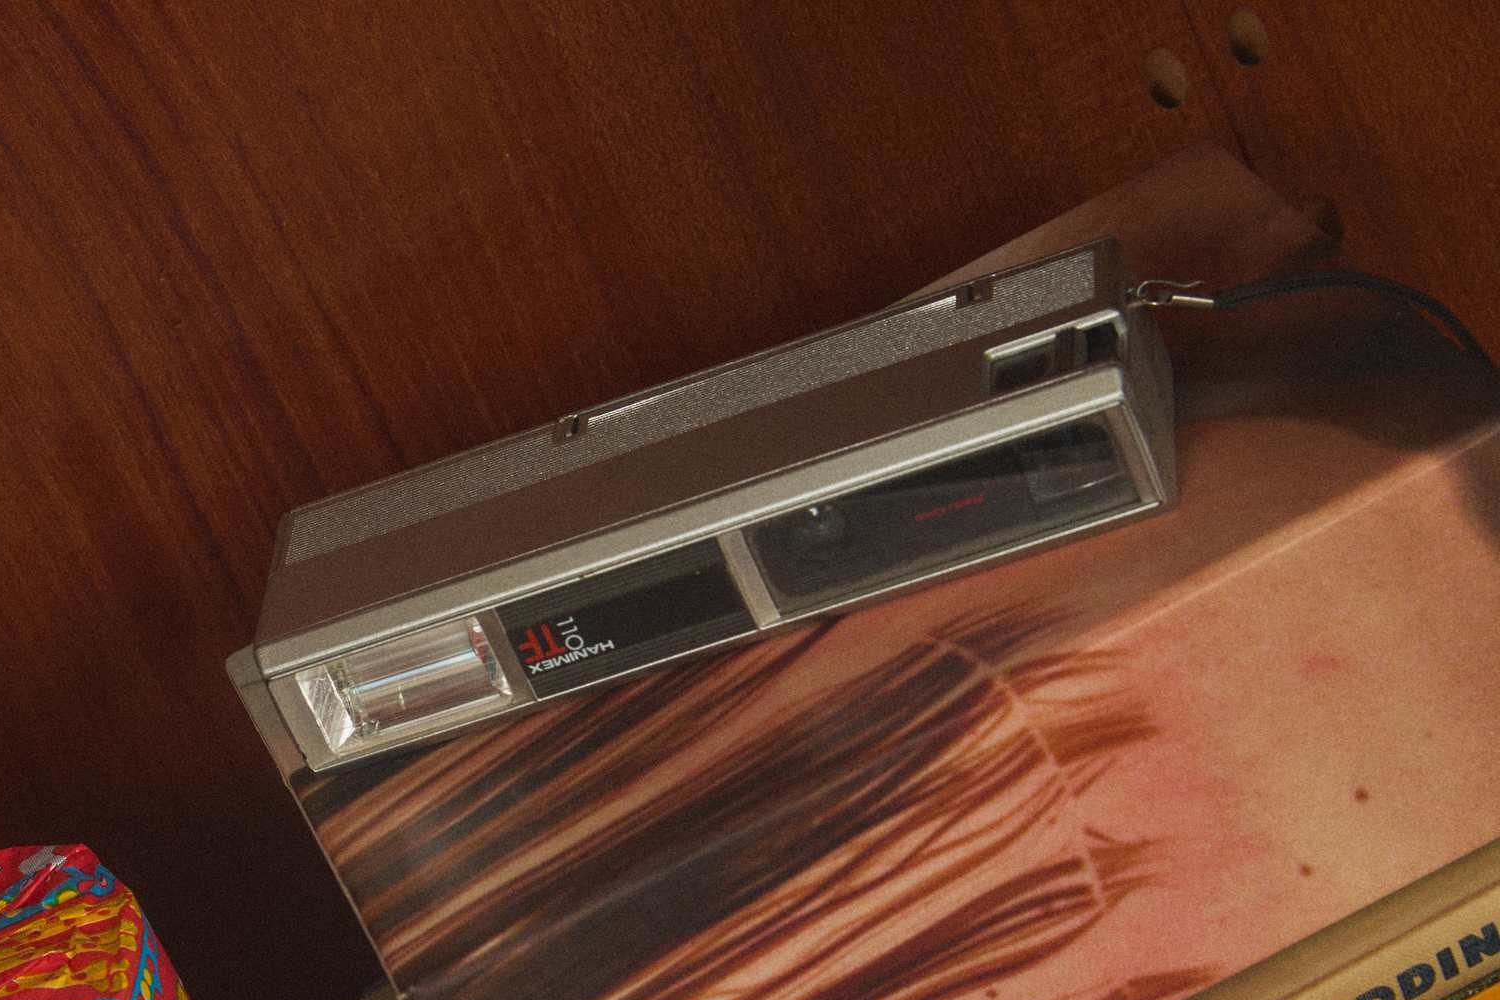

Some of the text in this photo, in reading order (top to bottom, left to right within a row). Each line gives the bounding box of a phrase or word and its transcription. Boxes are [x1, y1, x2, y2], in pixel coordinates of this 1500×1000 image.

[517, 623, 566, 665] TF
[556, 616, 585, 651] 110
[528, 639, 615, 675] HANIMEX
